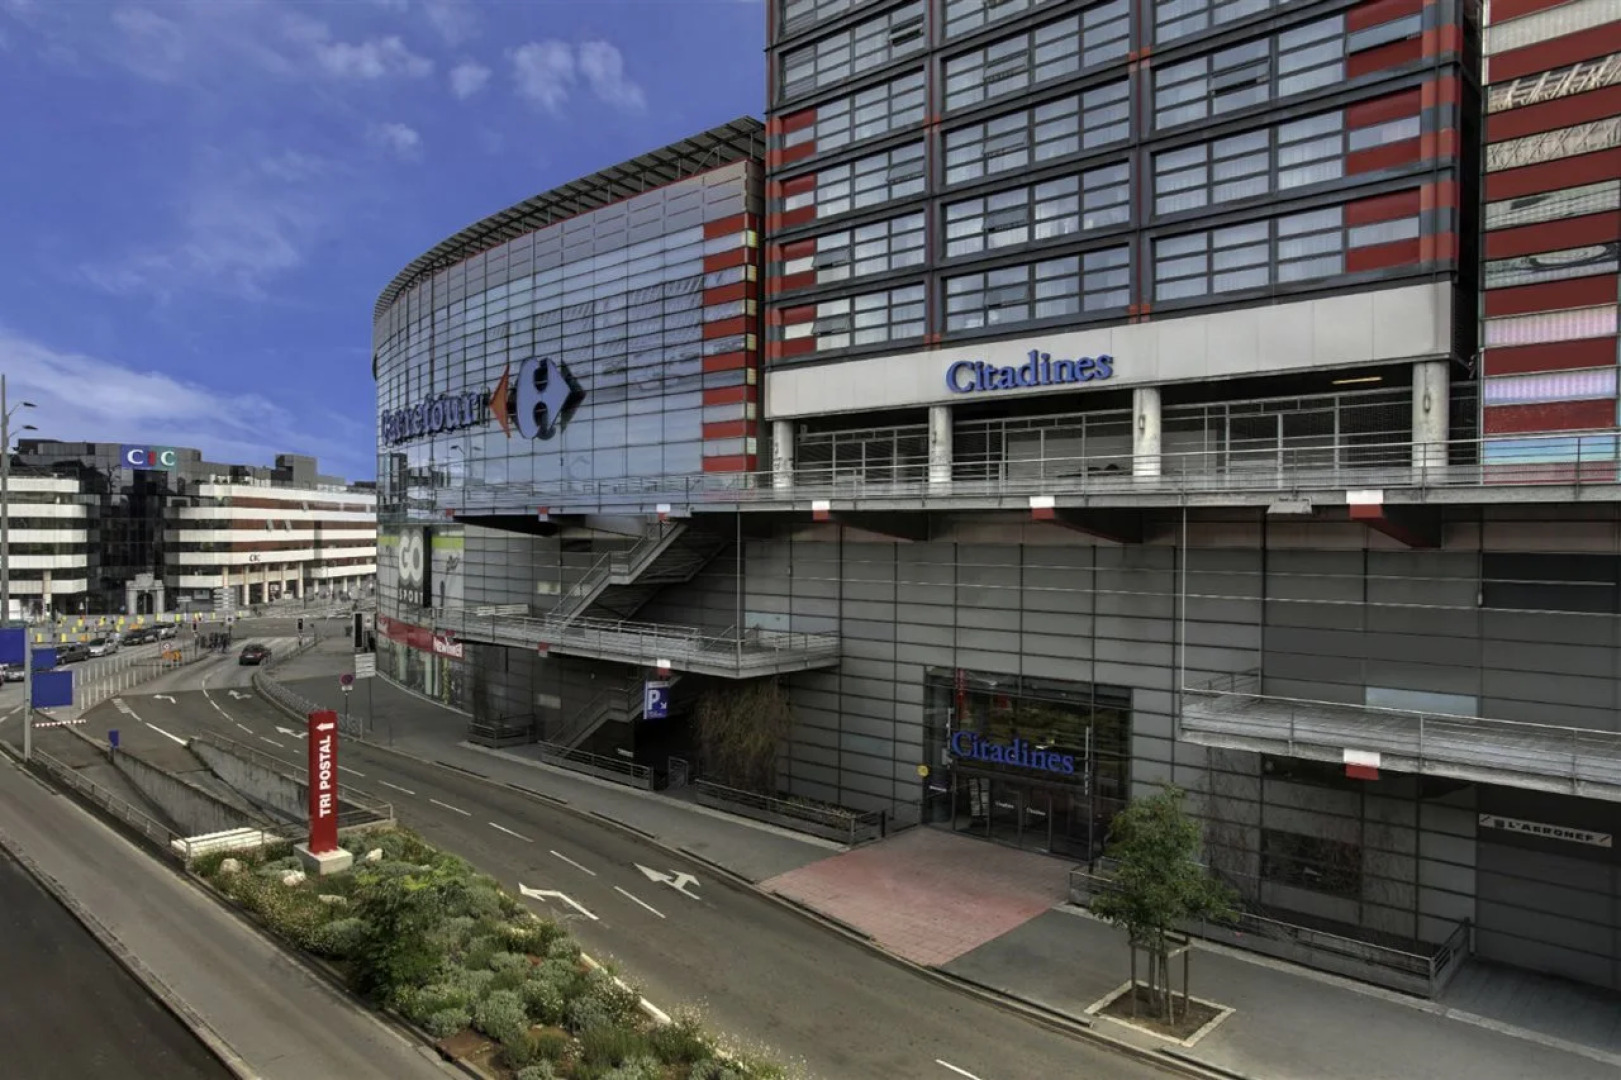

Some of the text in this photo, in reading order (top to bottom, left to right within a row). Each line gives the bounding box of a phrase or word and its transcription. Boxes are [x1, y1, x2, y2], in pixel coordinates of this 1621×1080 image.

[946, 349, 1114, 393] Citadines
[127, 448, 175, 467] CIC
[398, 535, 424, 581] GO
[399, 587, 424, 605] SPORT
[647, 689, 661, 710] P
[951, 731, 1075, 775] Citadines
[319, 734, 332, 819] TRI POSTAL
